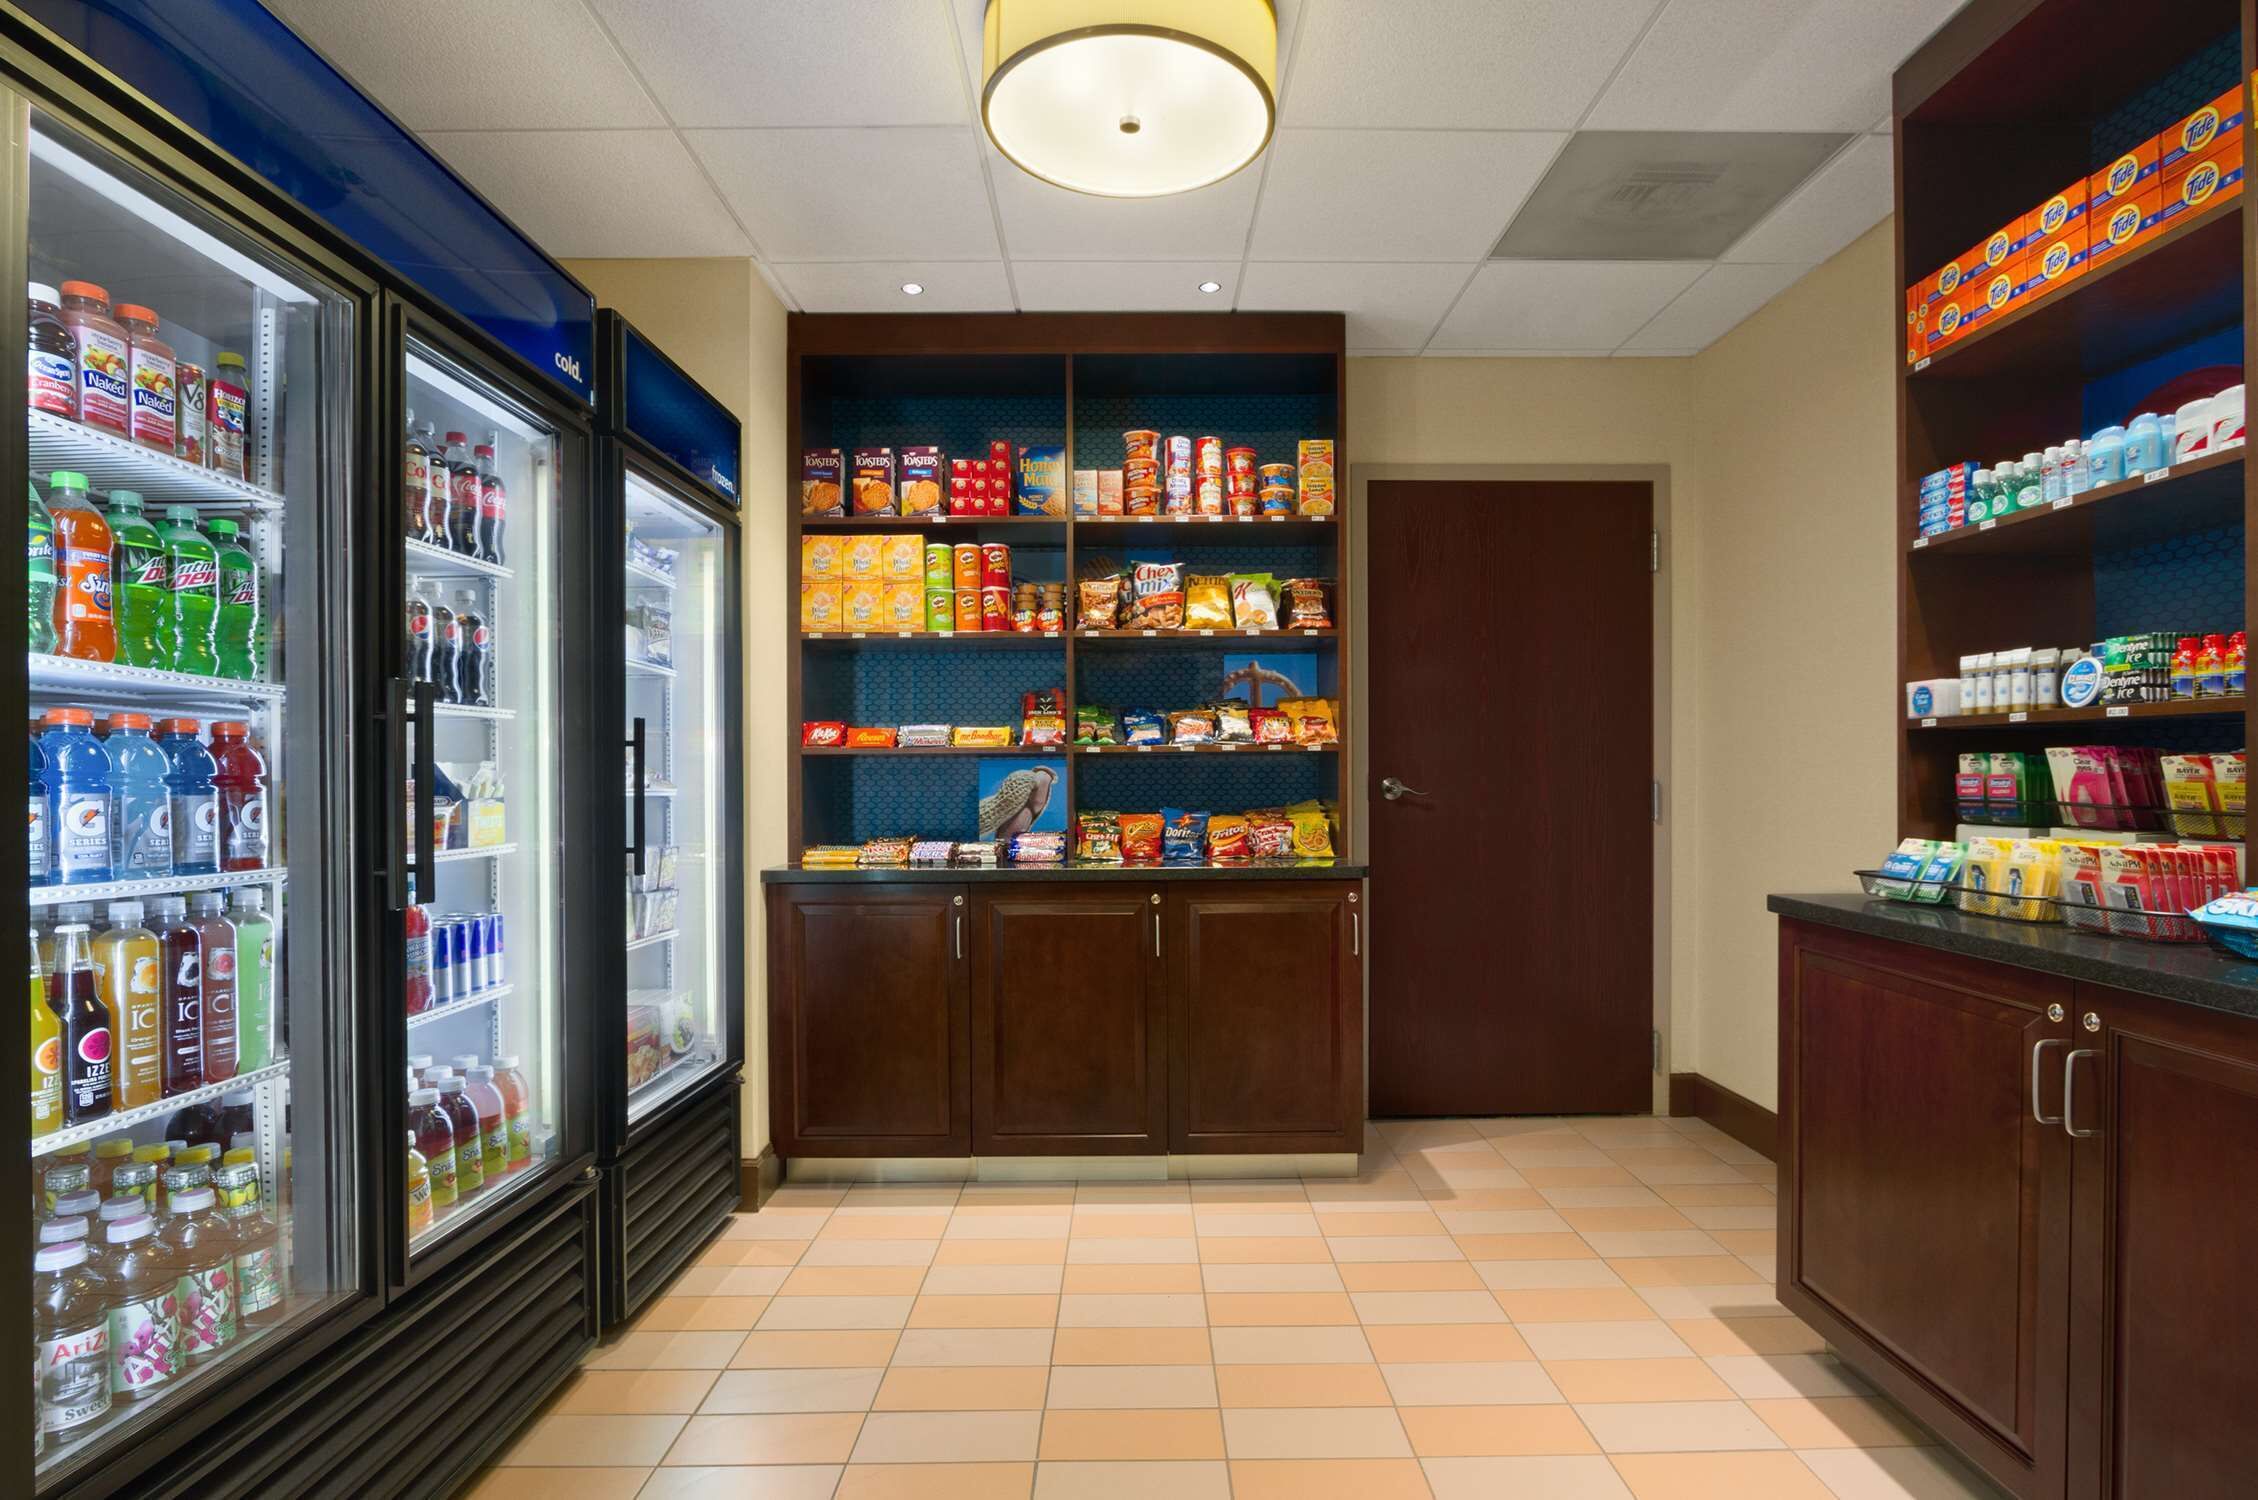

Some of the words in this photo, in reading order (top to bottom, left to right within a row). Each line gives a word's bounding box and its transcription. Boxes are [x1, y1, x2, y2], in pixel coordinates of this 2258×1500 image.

[2187, 115, 2215, 147] Tide
[2112, 162, 2135, 191] Tide
[2187, 171, 2215, 201] Tide
[2044, 202, 2065, 229] Tide
[2112, 211, 2137, 240] Tide
[1989, 239, 2007, 262] Tide
[2046, 249, 2067, 275] Tide
[1990, 282, 2008, 304] Tide
[1942, 310, 1958, 330] Tide
[555, 351, 583, 383] cold.
[88, 372, 126, 396] Naked
[138, 392, 173, 415] Naked
[855, 455, 890, 467] TOASTEDS
[902, 454, 938, 467] TOASTEDS
[1136, 566, 1173, 581] Chex
[1211, 826, 1244, 840] Fritos
